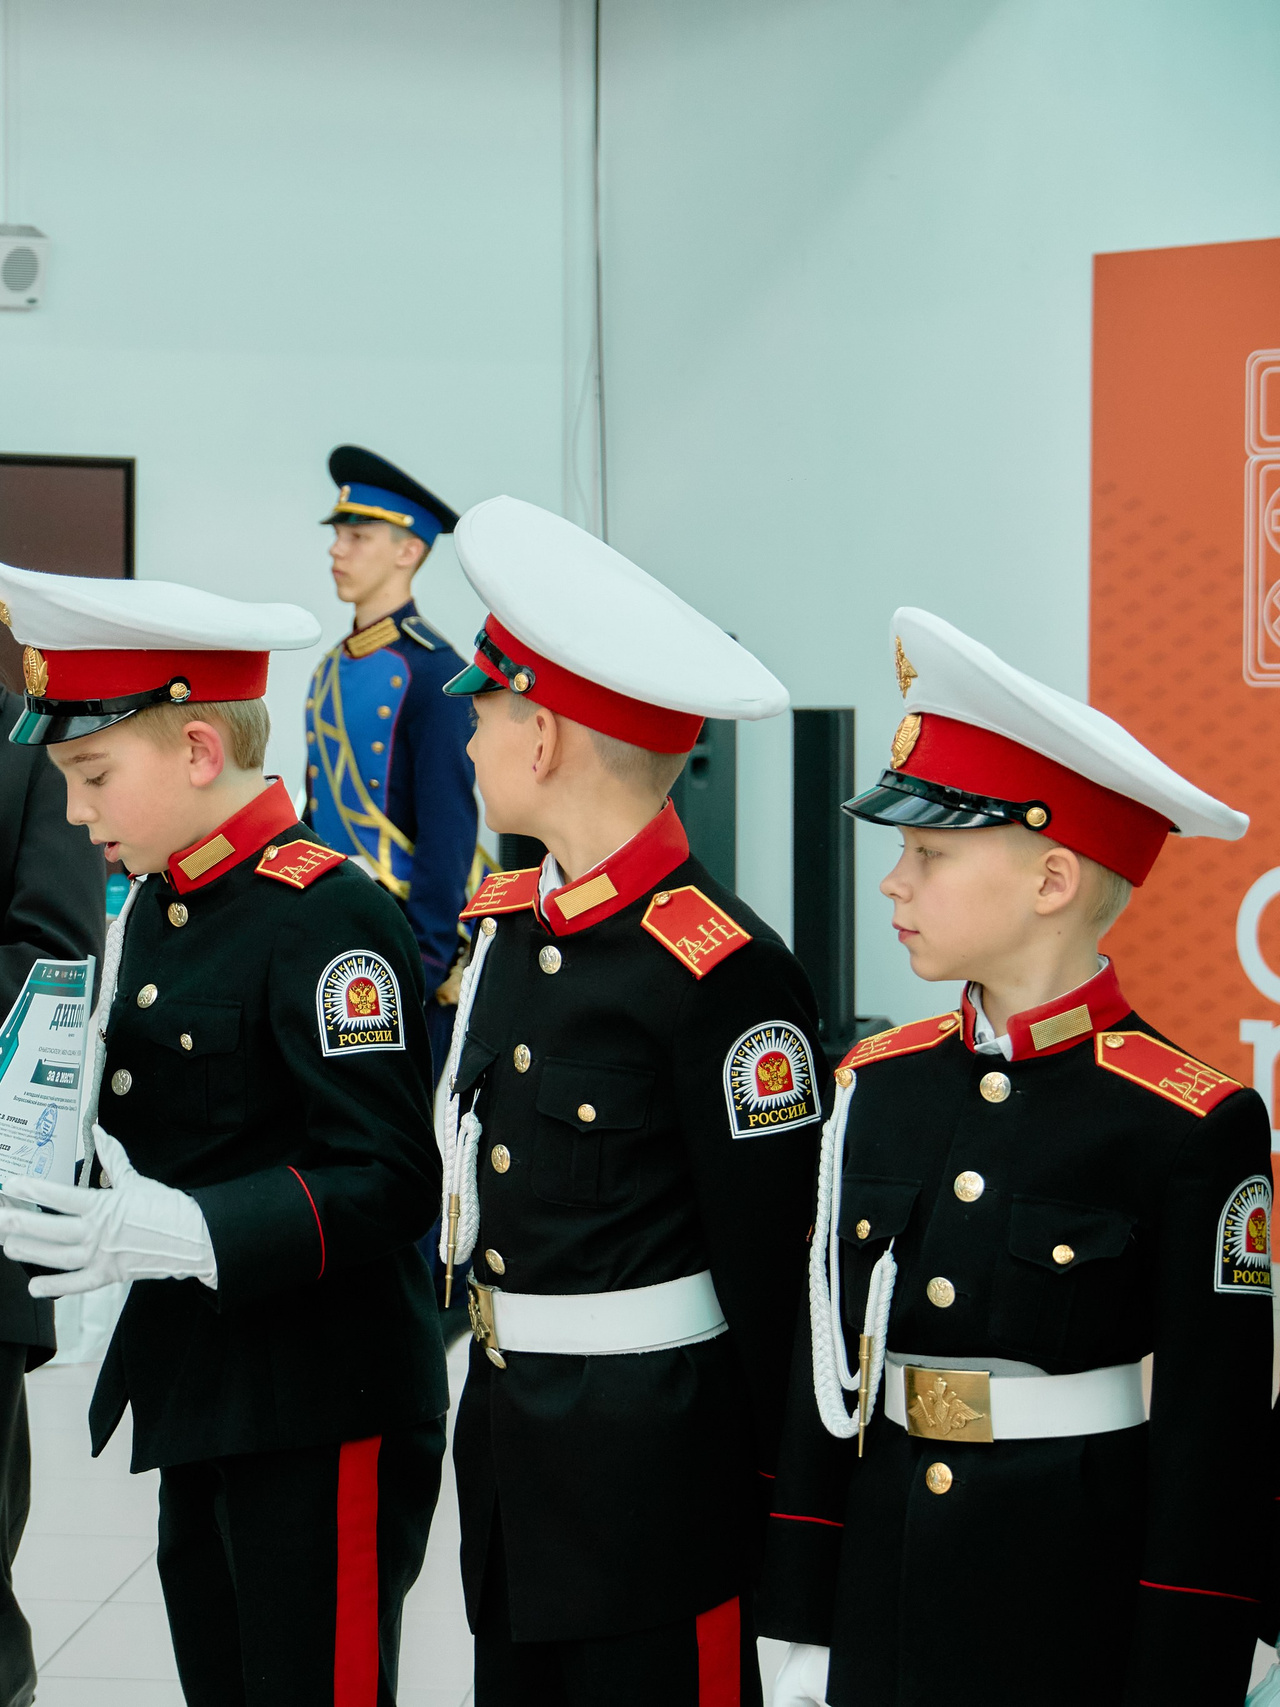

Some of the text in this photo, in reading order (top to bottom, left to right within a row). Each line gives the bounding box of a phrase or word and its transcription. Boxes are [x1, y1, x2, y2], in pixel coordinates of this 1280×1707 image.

[49, 1003, 85, 1031] ДИПЛО
[324, 957, 398, 1031] КАДЕТСКИЕ КОРПУСА
[338, 1030, 393, 1046] РОССИИ
[731, 1030, 811, 1110] КАДЕТСКИЕ КОРПУСА
[748, 1102, 808, 1127] РОССИИ
[1223, 1185, 1262, 1263] КАДЕТСКИЕ
